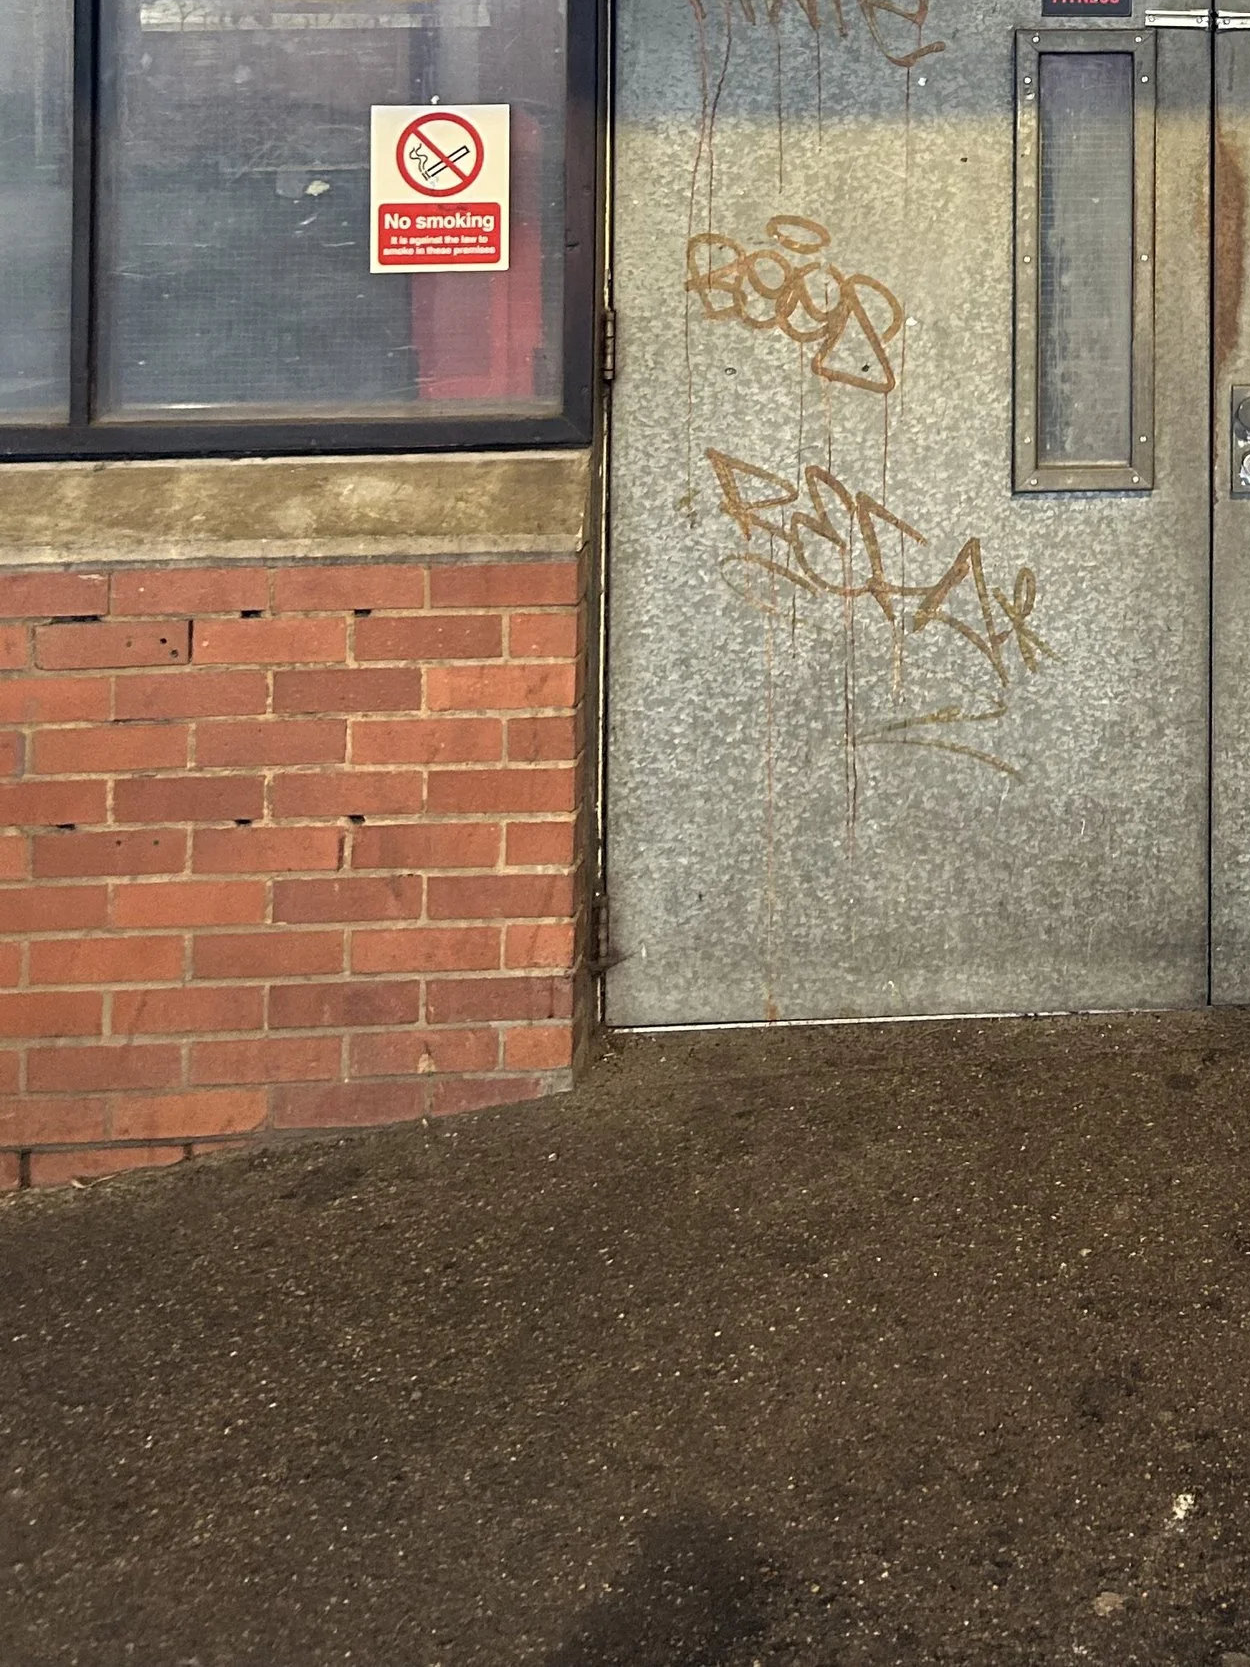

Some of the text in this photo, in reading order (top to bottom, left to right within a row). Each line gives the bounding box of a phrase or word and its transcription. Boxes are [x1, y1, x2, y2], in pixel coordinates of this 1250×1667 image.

[384, 211, 495, 233] No smoking
[409, 235, 443, 246] against
[444, 234, 459, 244] the
[478, 234, 489, 244] to
[453, 244, 497, 256] premises
